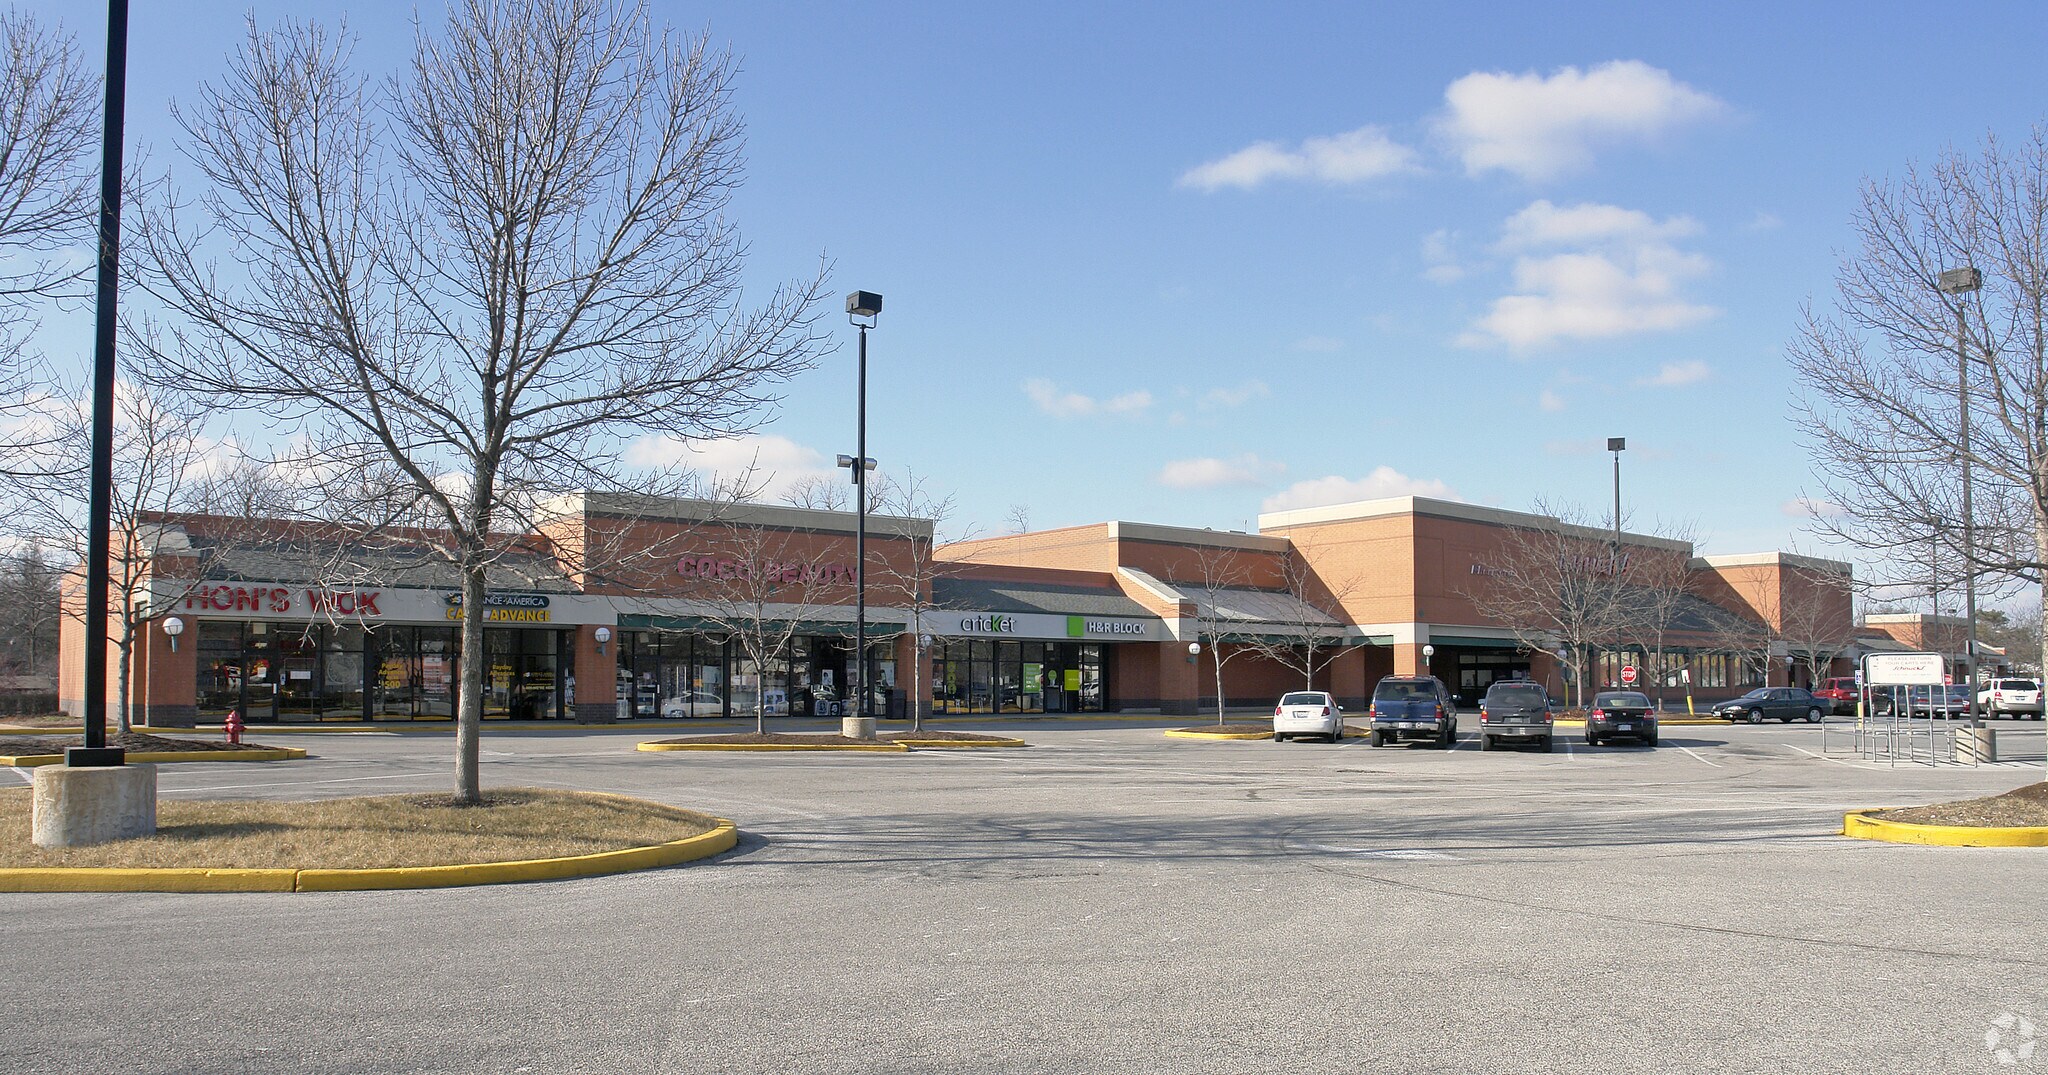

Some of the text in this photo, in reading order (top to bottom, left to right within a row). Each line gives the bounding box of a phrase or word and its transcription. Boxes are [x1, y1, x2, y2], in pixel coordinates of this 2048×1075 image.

[186, 585, 381, 615] HON'S WOK
[506, 597, 545, 606] AMERICA
[489, 609, 551, 621] ADVANCE
[1088, 622, 1146, 634] H&R BLOCK
[1622, 670, 1635, 678] STOP
